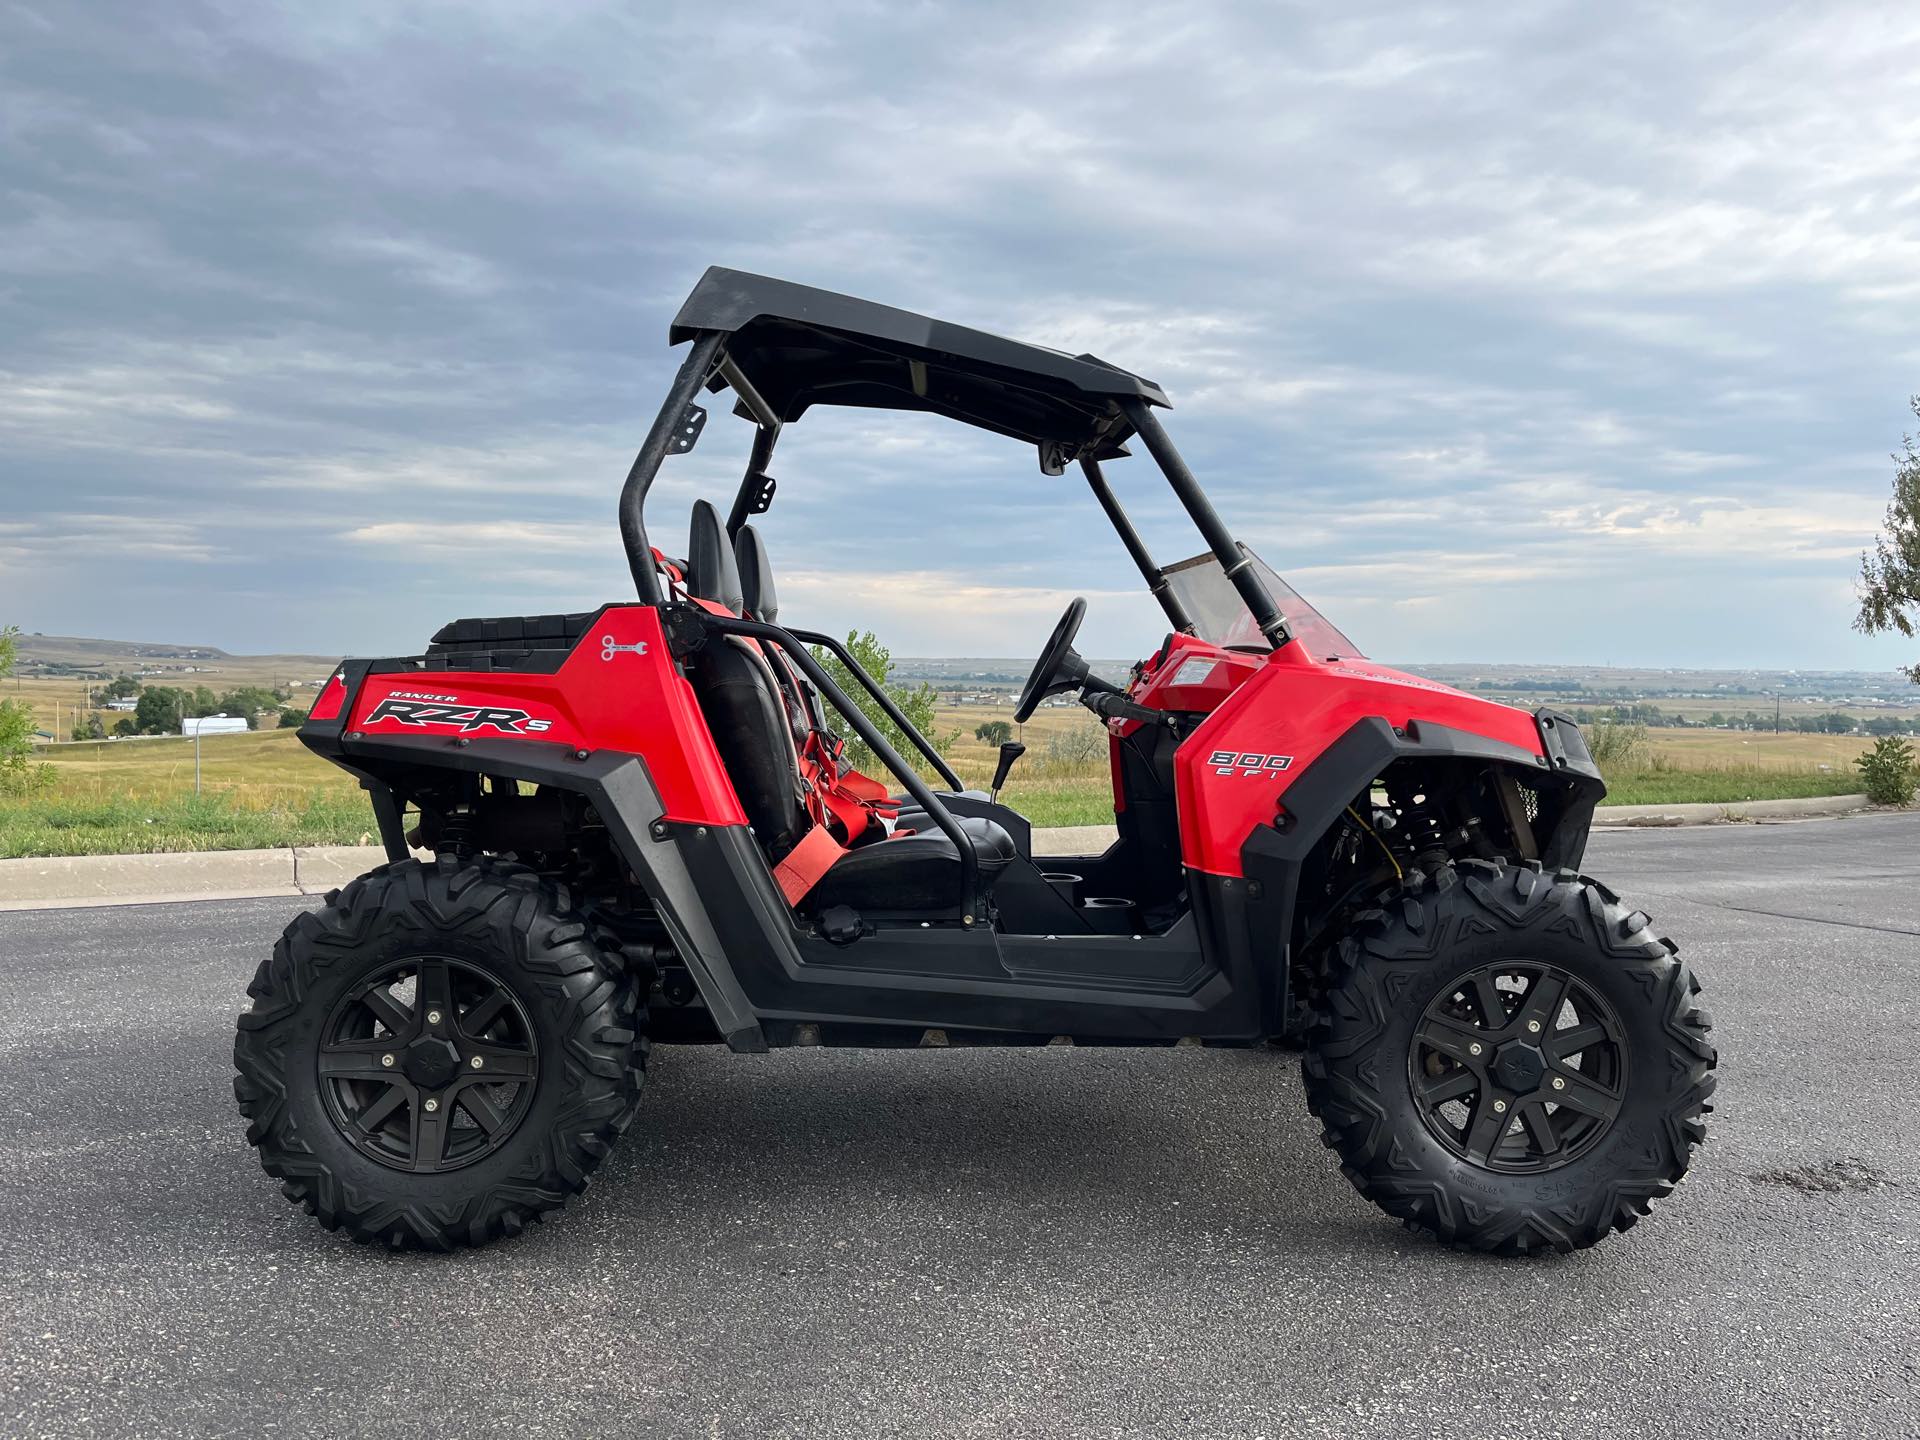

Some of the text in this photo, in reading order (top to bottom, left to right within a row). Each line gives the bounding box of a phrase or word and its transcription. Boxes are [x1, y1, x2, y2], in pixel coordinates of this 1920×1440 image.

[389, 691, 458, 702] RANGER
[363, 699, 553, 734] RZR S
[1207, 750, 1294, 771] 800
[1215, 767, 1278, 779] EFI
